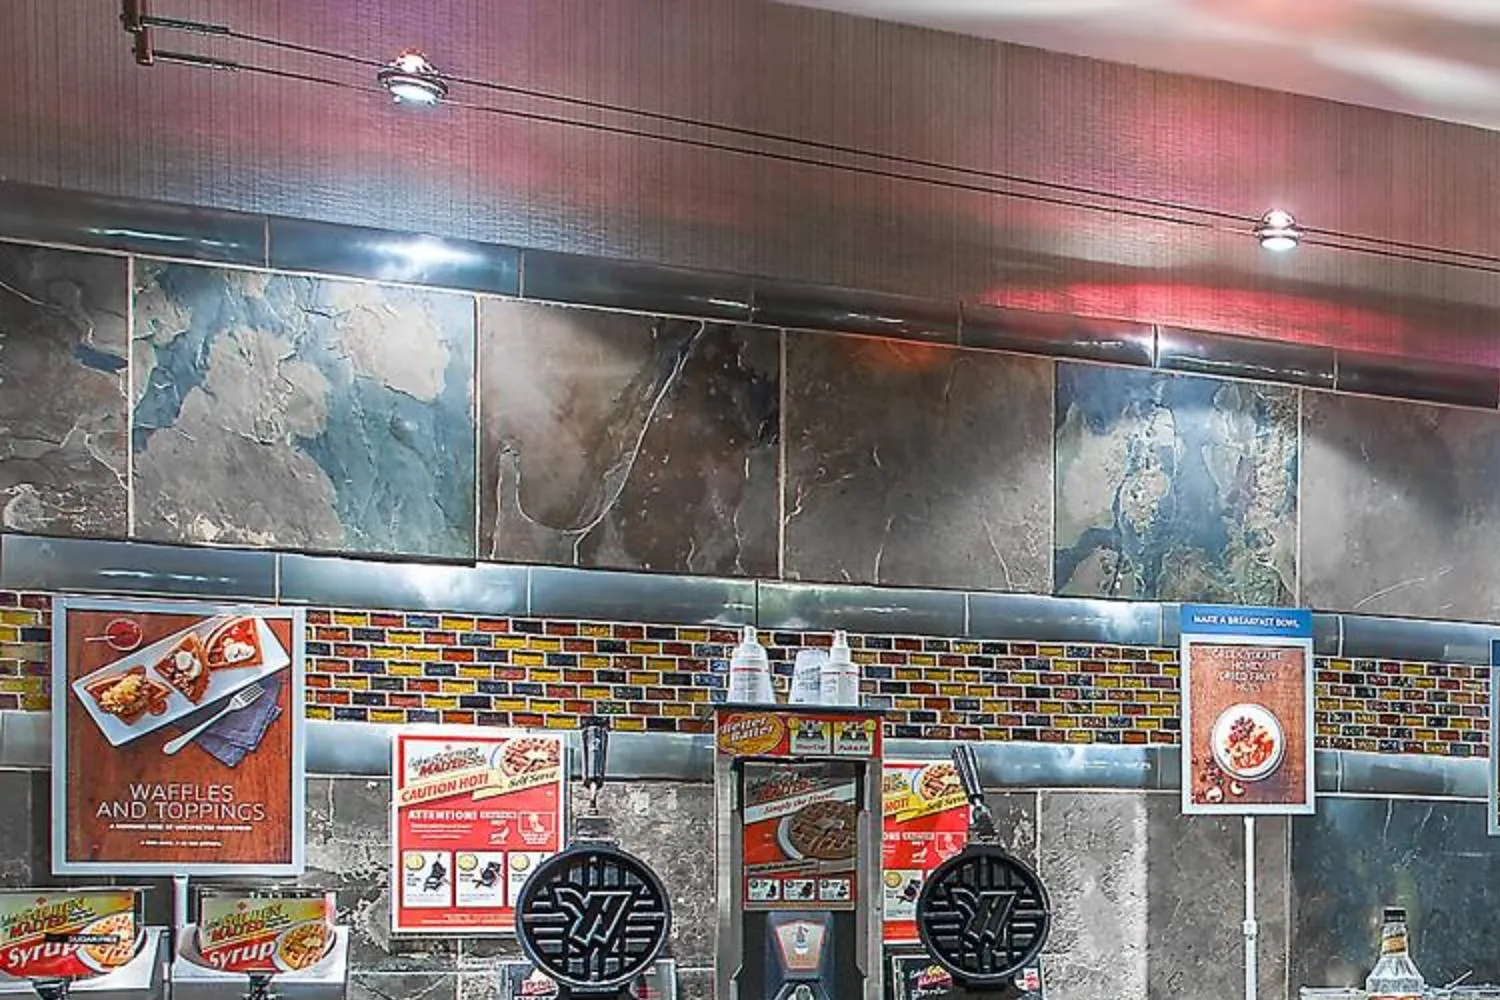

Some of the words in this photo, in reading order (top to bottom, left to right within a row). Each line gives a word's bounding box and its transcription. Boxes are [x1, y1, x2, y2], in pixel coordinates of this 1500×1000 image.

[1193, 613, 1217, 623] MAKE
[1227, 616, 1274, 626] BREAKFAST
[1275, 618, 1300, 628] BOWL
[401, 780, 457, 802] CAUTION
[459, 772, 489, 789] HOT!
[507, 776, 527, 789] Self
[129, 783, 234, 803] WAFFLES
[96, 801, 147, 819] AND
[154, 801, 265, 821] TOPPINGS
[408, 809, 477, 820] ATTENTION!
[8, 942, 80, 968] Syrup
[208, 942, 275, 969] Syrup
